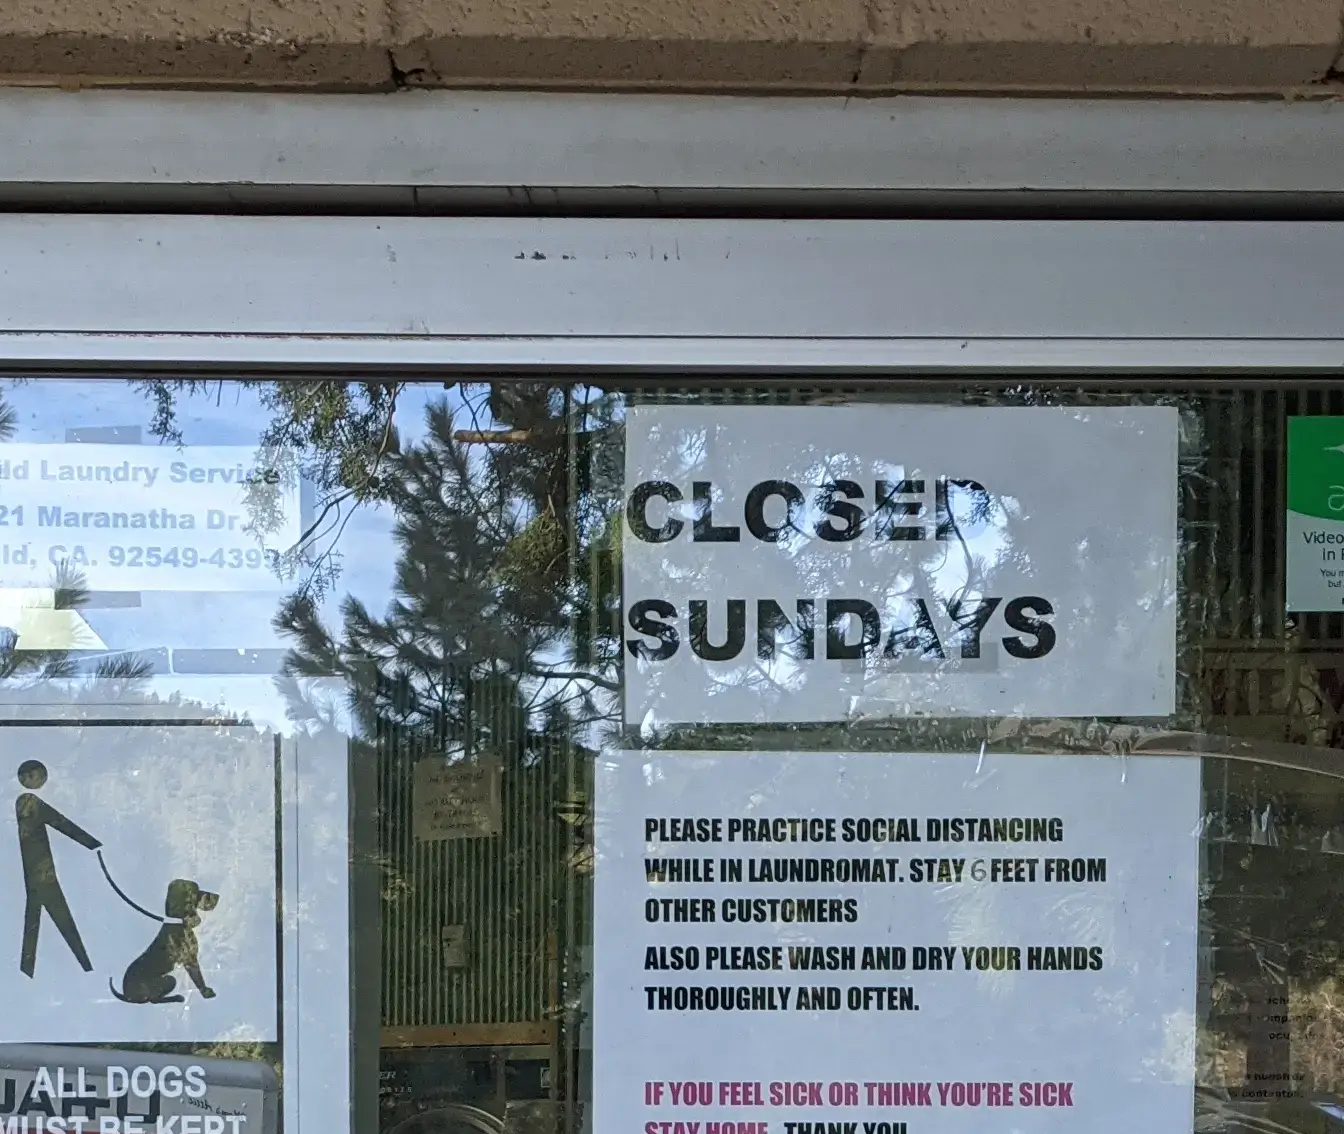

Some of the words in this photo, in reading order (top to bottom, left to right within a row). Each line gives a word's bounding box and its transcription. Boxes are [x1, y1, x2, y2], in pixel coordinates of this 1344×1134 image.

[40, 460, 159, 488] Laundry
[37, 505, 196, 530] Maranatha
[1302, 531, 1344, 545] Video
[1322, 548, 1336, 561] in
[1320, 569, 1336, 578] You
[1328, 580, 1342, 588] but
[626, 596, 1057, 661] SUNDAYS
[643, 815, 723, 847] PLEASE
[726, 815, 837, 847] PRACTICE
[840, 815, 922, 847] SOCIAL
[925, 814, 1064, 847] DISTANCING
[643, 853, 715, 887] WHILE
[718, 855, 743, 887] IN
[747, 853, 905, 887] LAUNDROMAT.
[907, 853, 967, 887] STAY
[969, 855, 987, 887] 6
[989, 853, 1040, 884] FEET
[1043, 855, 1107, 887] FROM
[643, 894, 716, 924] OTHER
[720, 894, 859, 926] CUSTOMERS
[31, 1066, 97, 1098] ALL
[107, 1065, 207, 1098] DOGS
[643, 1081, 665, 1107] IF
[667, 1080, 714, 1109] YOU
[717, 1079, 765, 1109] FEEL
[767, 1080, 824, 1110] SICK
[827, 1081, 859, 1110] OR
[862, 1079, 933, 1110] THINK
[935, 1080, 1015, 1108] YOU'RE
[1017, 1080, 1074, 1108] SICK
